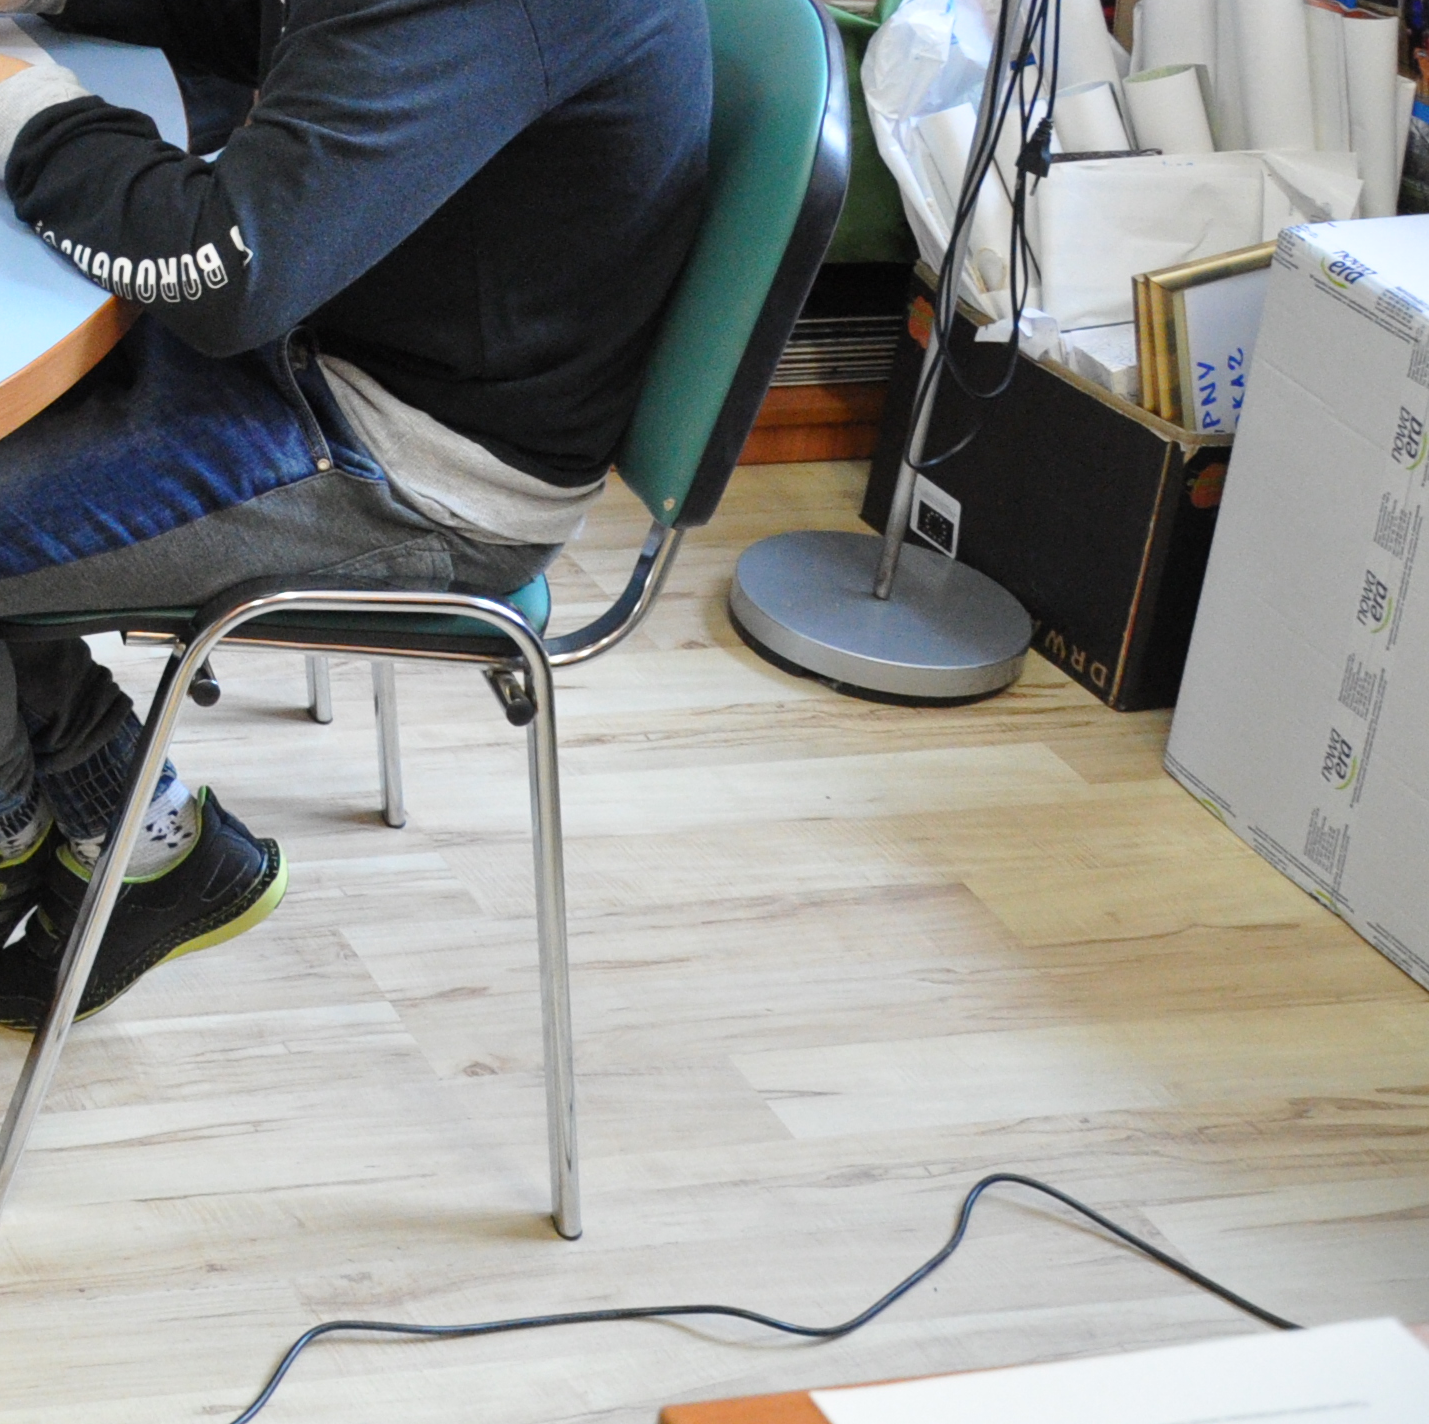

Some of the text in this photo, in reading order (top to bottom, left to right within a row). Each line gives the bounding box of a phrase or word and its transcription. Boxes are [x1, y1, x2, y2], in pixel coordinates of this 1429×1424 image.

[1327, 260, 1365, 285] era
[1391, 405, 1411, 464] nowa
[1404, 415, 1424, 460] era
[1356, 569, 1377, 627] nowa
[1369, 579, 1388, 623] era
[1320, 727, 1341, 783] nowa
[1334, 738, 1353, 781] era
